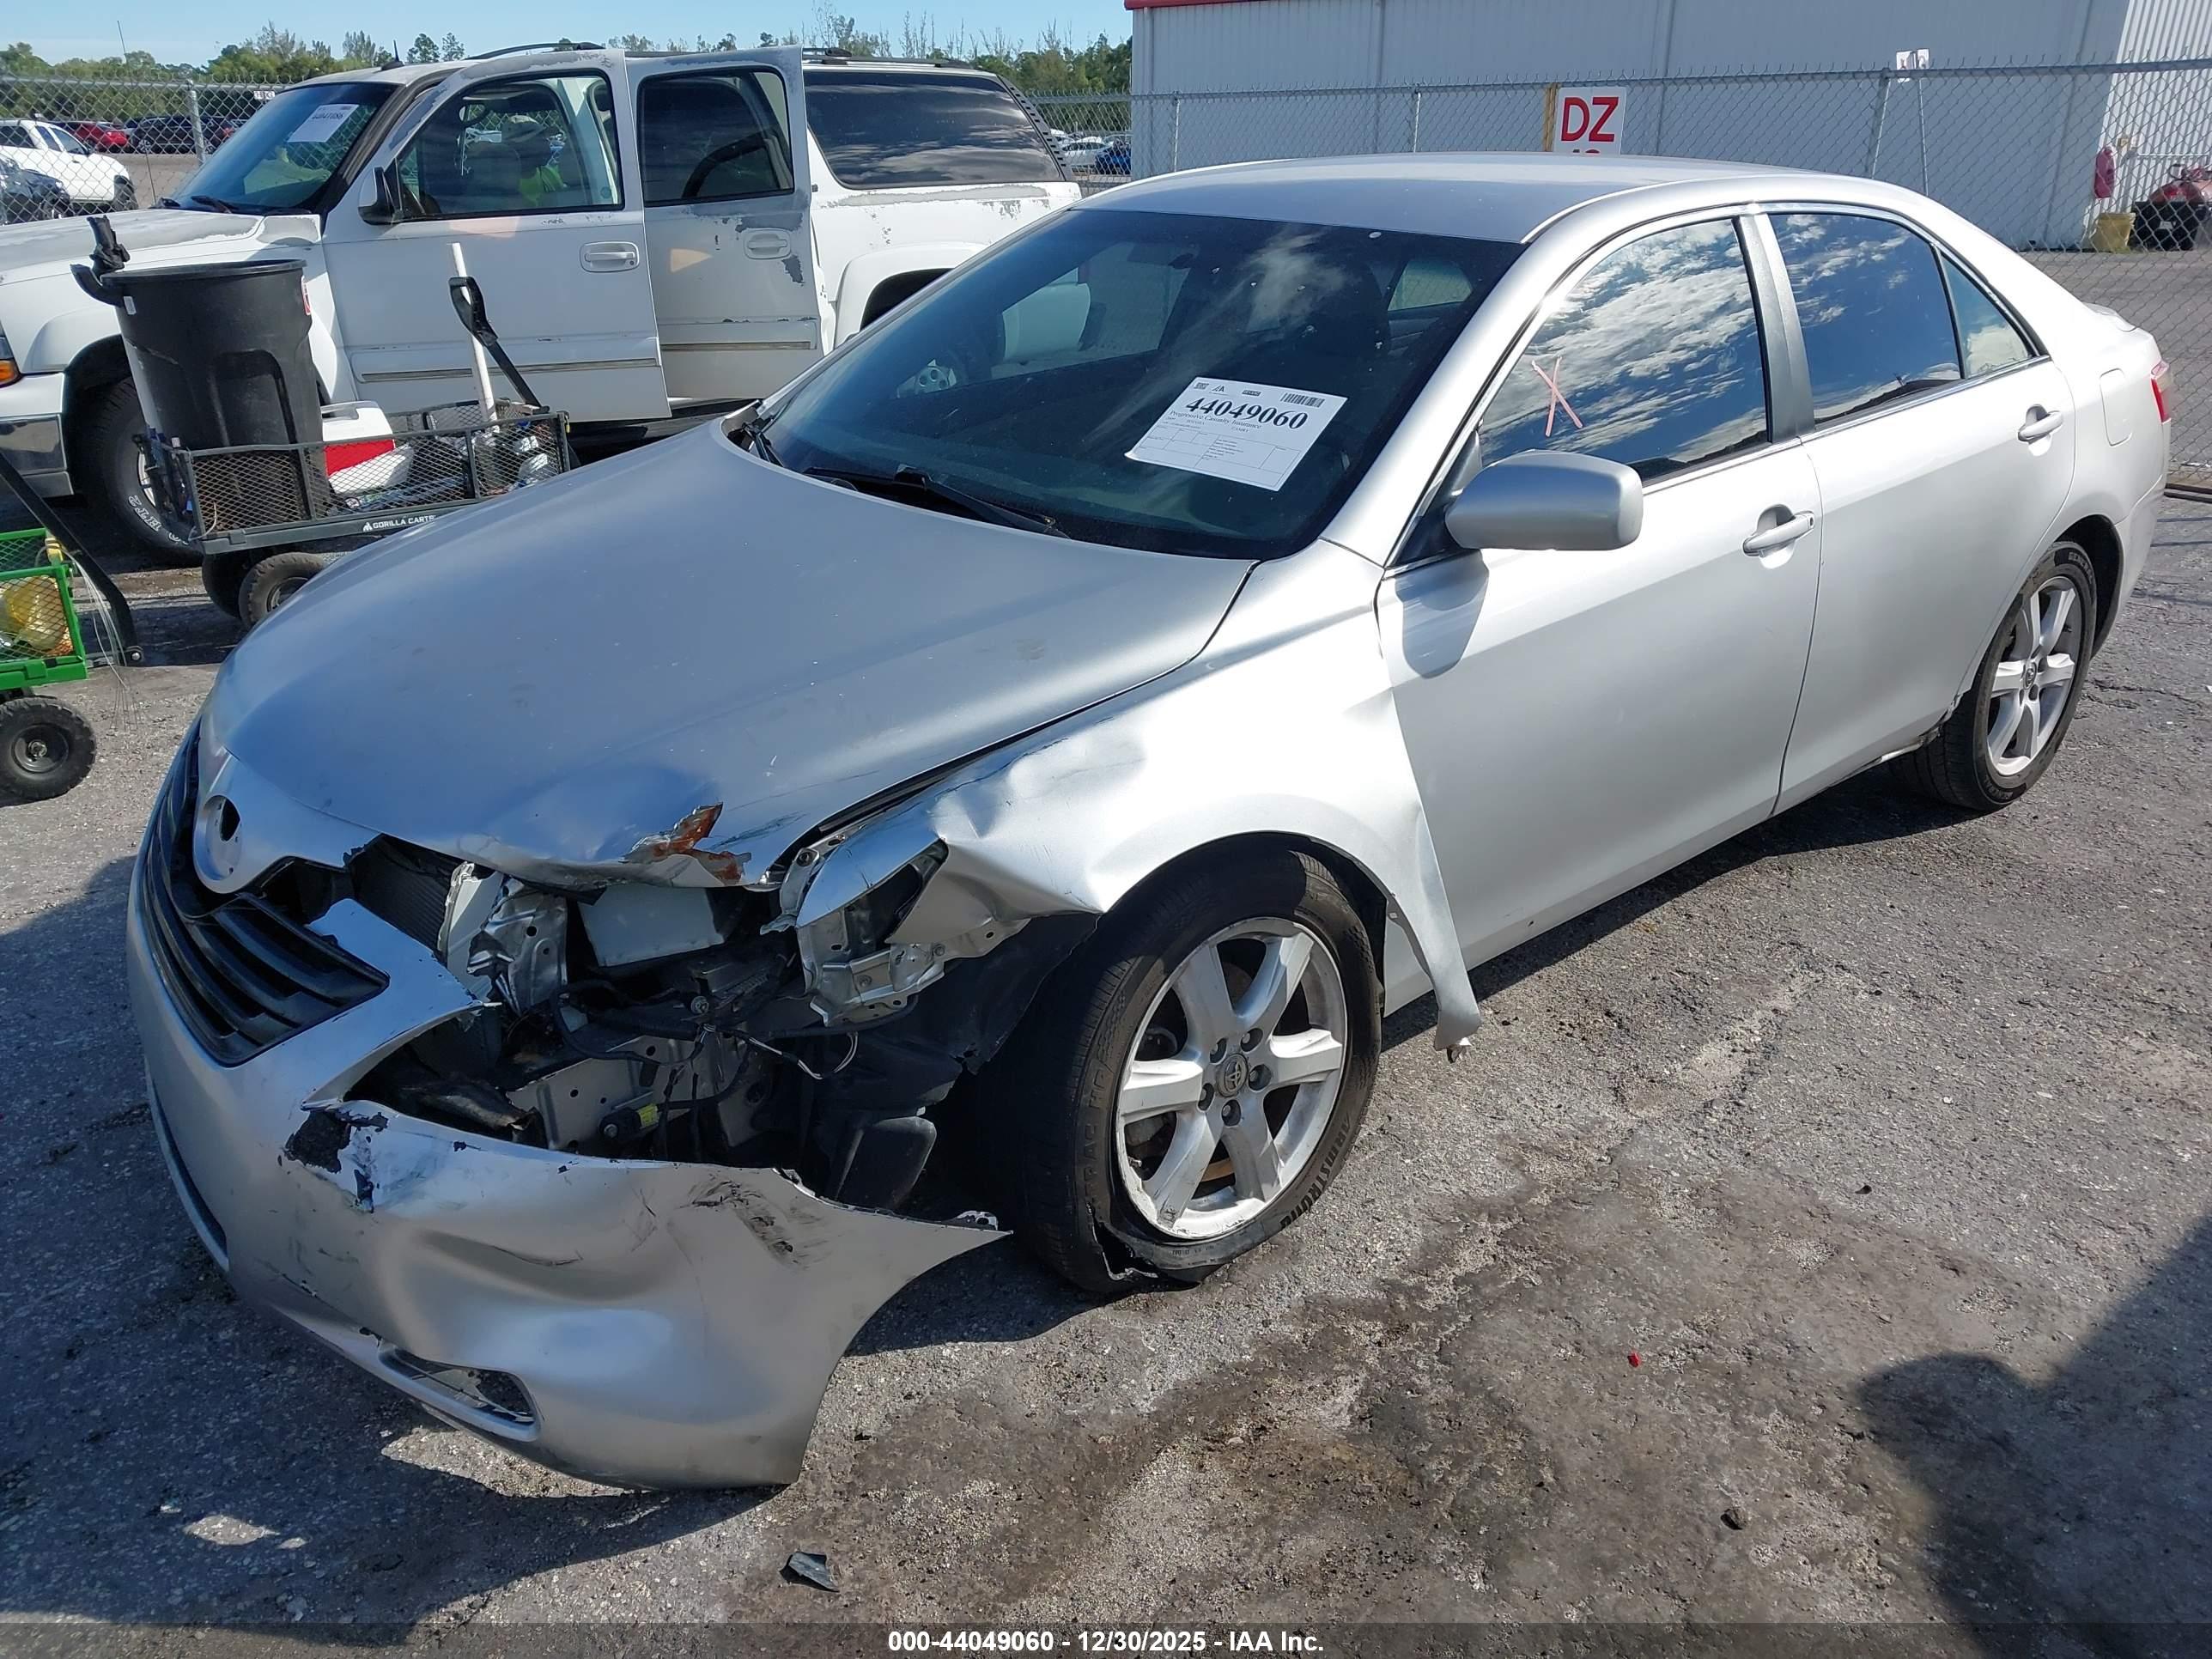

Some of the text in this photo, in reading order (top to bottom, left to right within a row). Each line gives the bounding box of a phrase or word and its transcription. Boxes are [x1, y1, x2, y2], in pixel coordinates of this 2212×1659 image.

[1560, 96, 1620, 143] DZ
[1169, 410, 1204, 420] Progressive
[1204, 415, 1231, 425] Casualty
[1231, 418, 1262, 428] Insurance
[1186, 398, 1309, 429] 44049060
[373, 519, 406, 529] GORILLA
